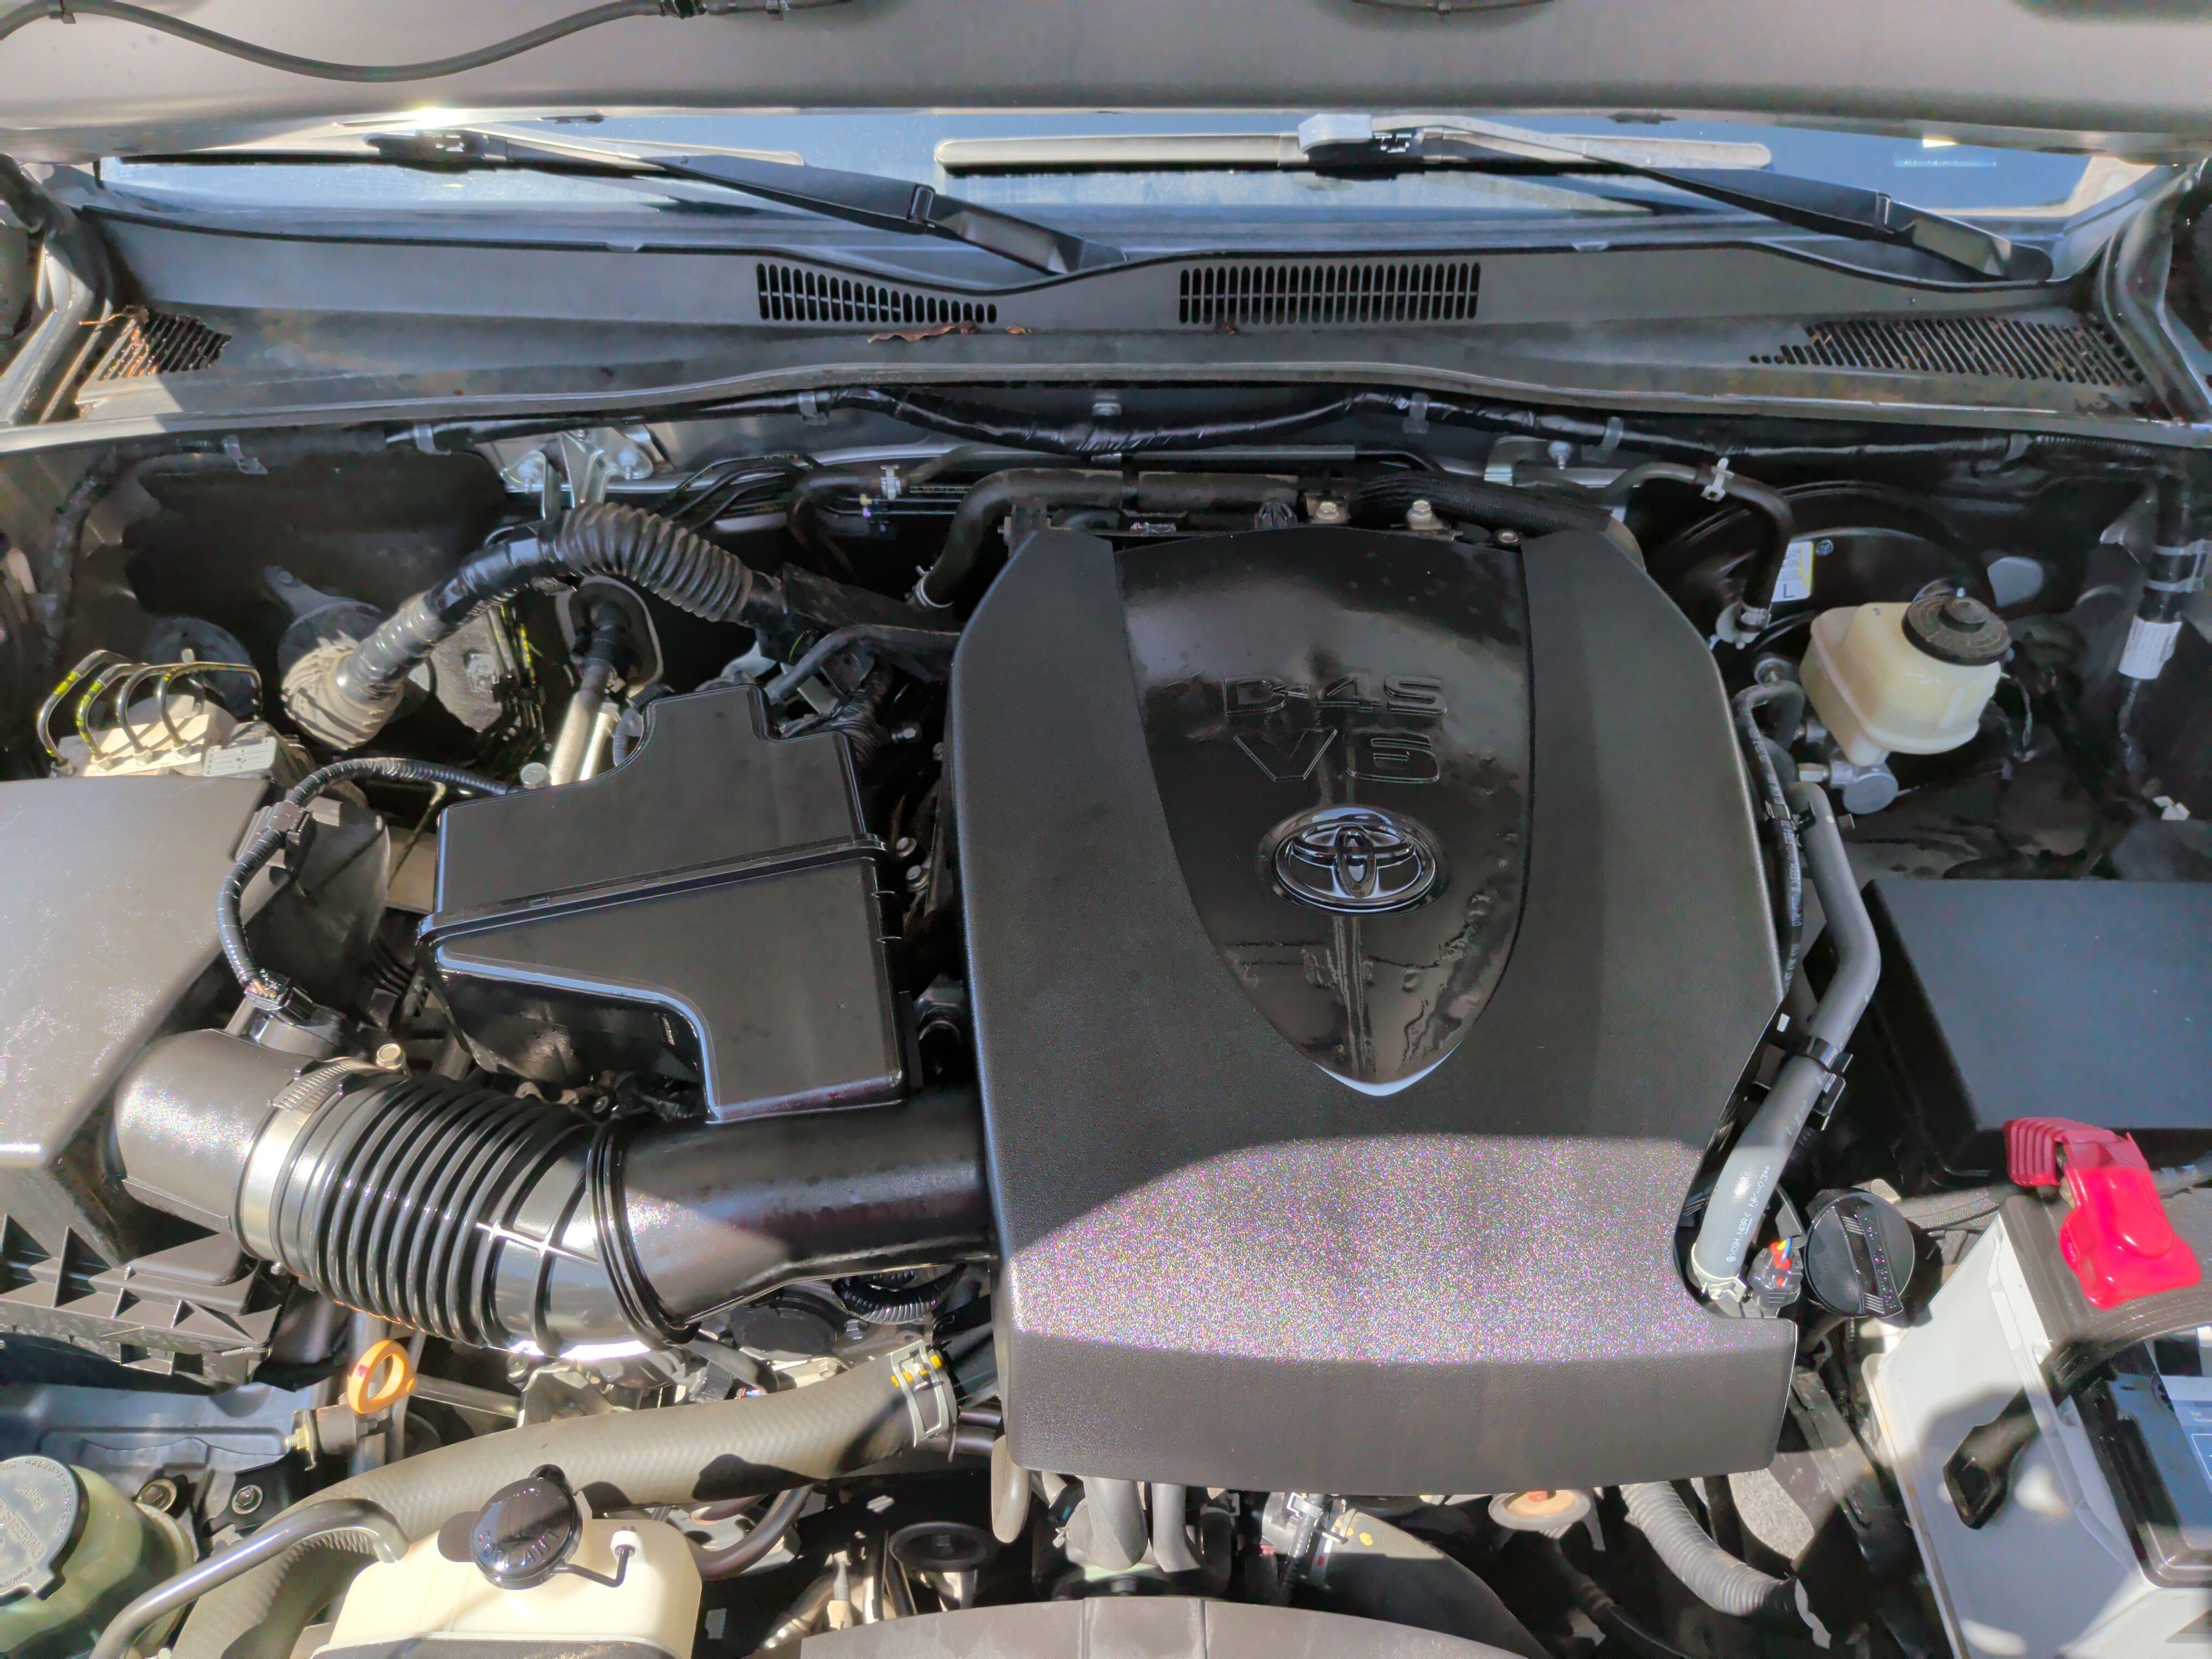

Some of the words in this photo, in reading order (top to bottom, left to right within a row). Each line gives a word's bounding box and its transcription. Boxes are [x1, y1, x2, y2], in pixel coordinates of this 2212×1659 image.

[1783, 583, 1794, 598] L
[1223, 673, 1448, 718] D-4S
[1233, 728, 1442, 784] V6
[3, 1509, 44, 1561] STEERING
[478, 1527, 560, 1569] COOLANT
